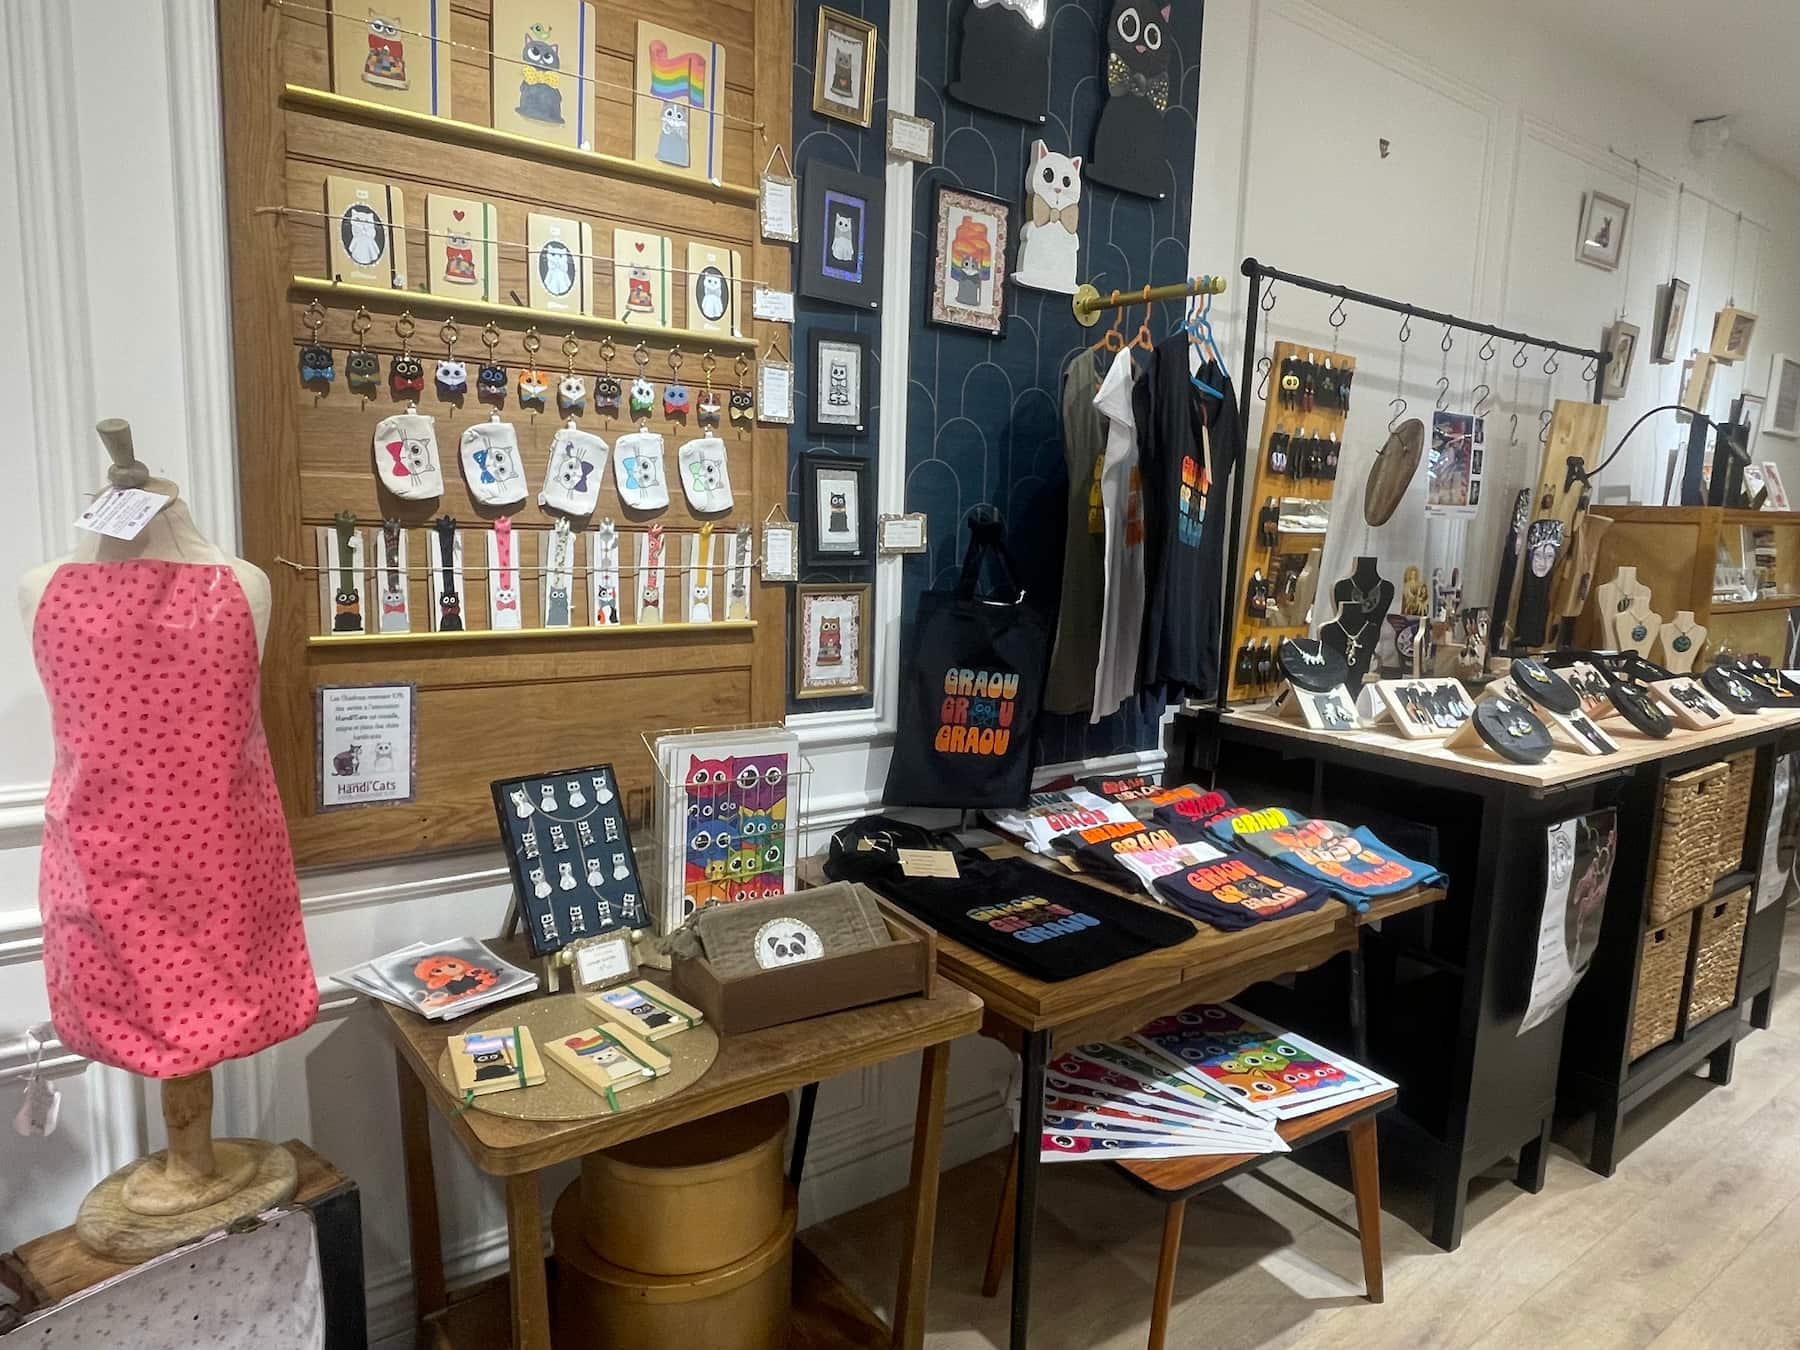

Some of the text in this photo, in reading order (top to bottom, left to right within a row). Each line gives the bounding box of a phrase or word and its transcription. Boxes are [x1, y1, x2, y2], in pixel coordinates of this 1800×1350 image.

[944, 667, 1019, 700] GRAOU
[934, 725, 1010, 755] GRAOU
[337, 780, 396, 794] Handi'Cats
[1186, 859, 1258, 892] GRAOU
